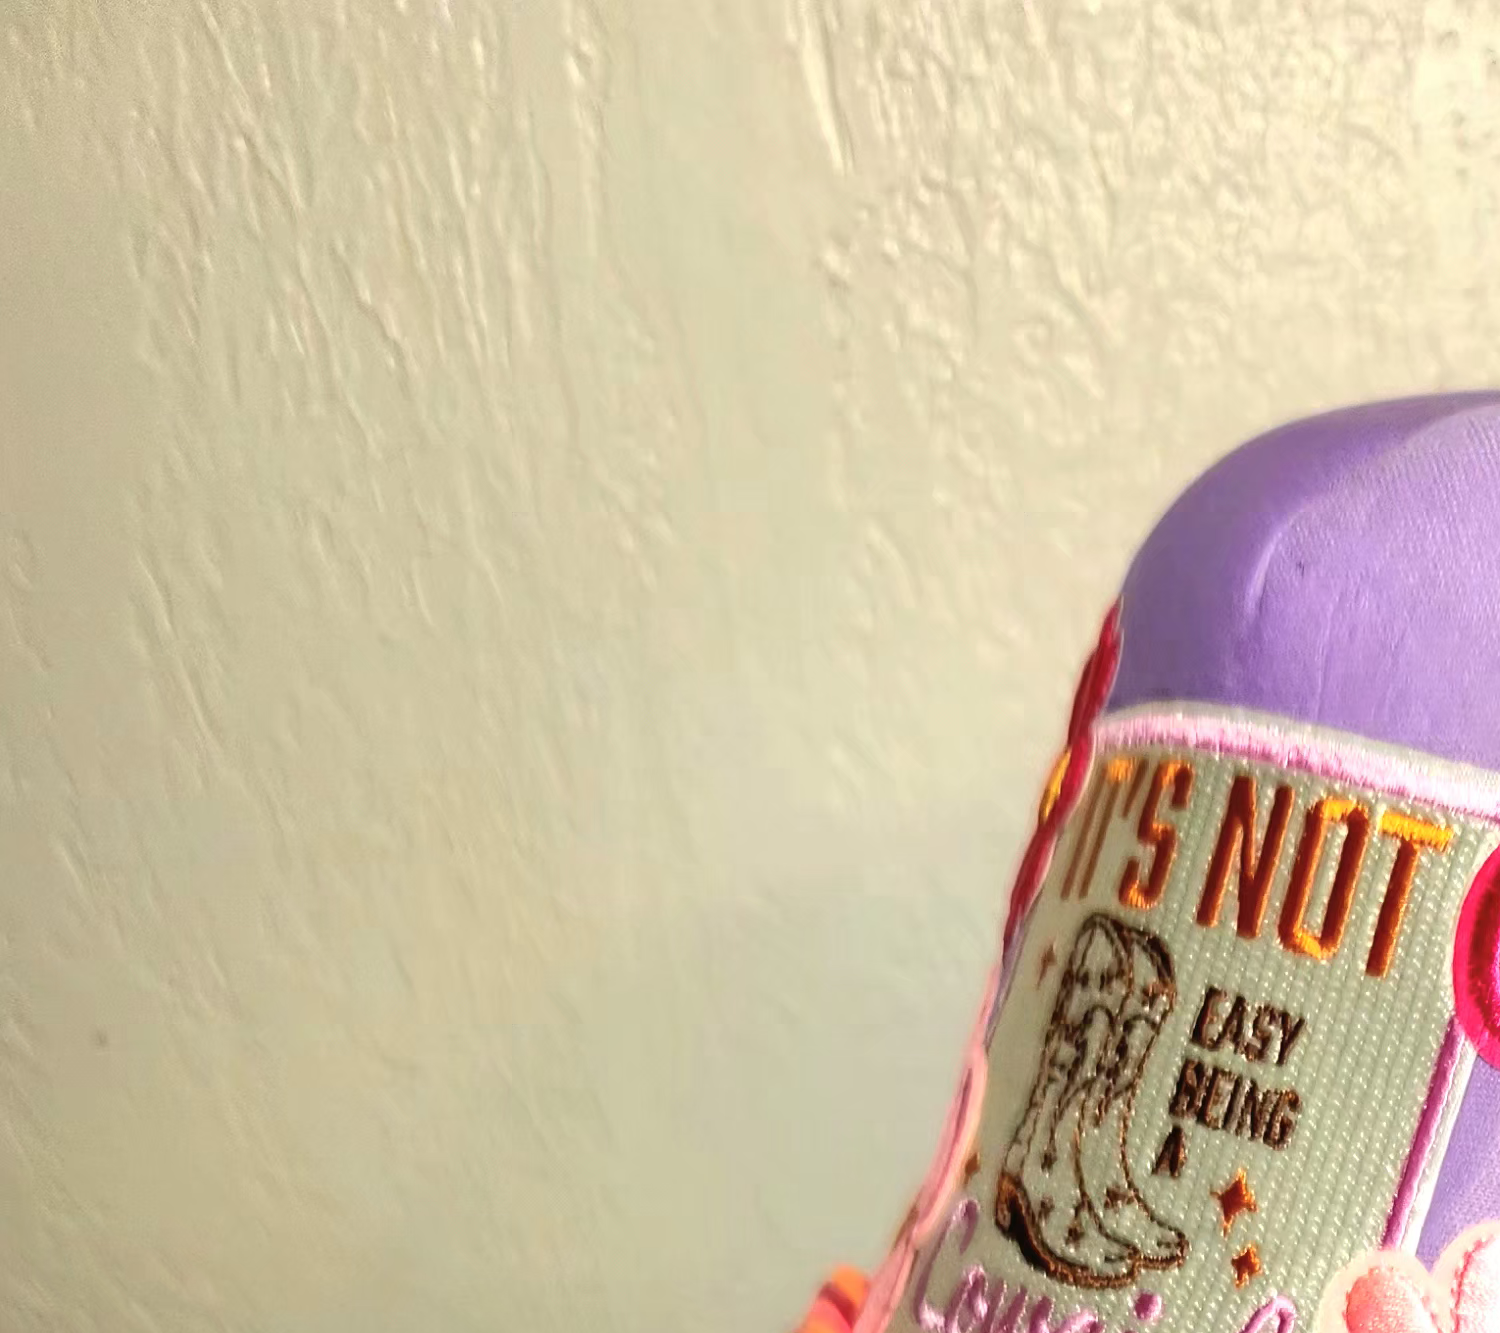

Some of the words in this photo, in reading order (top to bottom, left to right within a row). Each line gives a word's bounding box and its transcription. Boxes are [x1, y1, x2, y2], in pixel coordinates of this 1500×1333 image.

[1059, 756, 1194, 911] IT'S
[1195, 774, 1455, 979] NOT
[1190, 985, 1306, 1067] EASY
[1168, 1057, 1303, 1151] BEING
[1150, 1123, 1188, 1180] A
